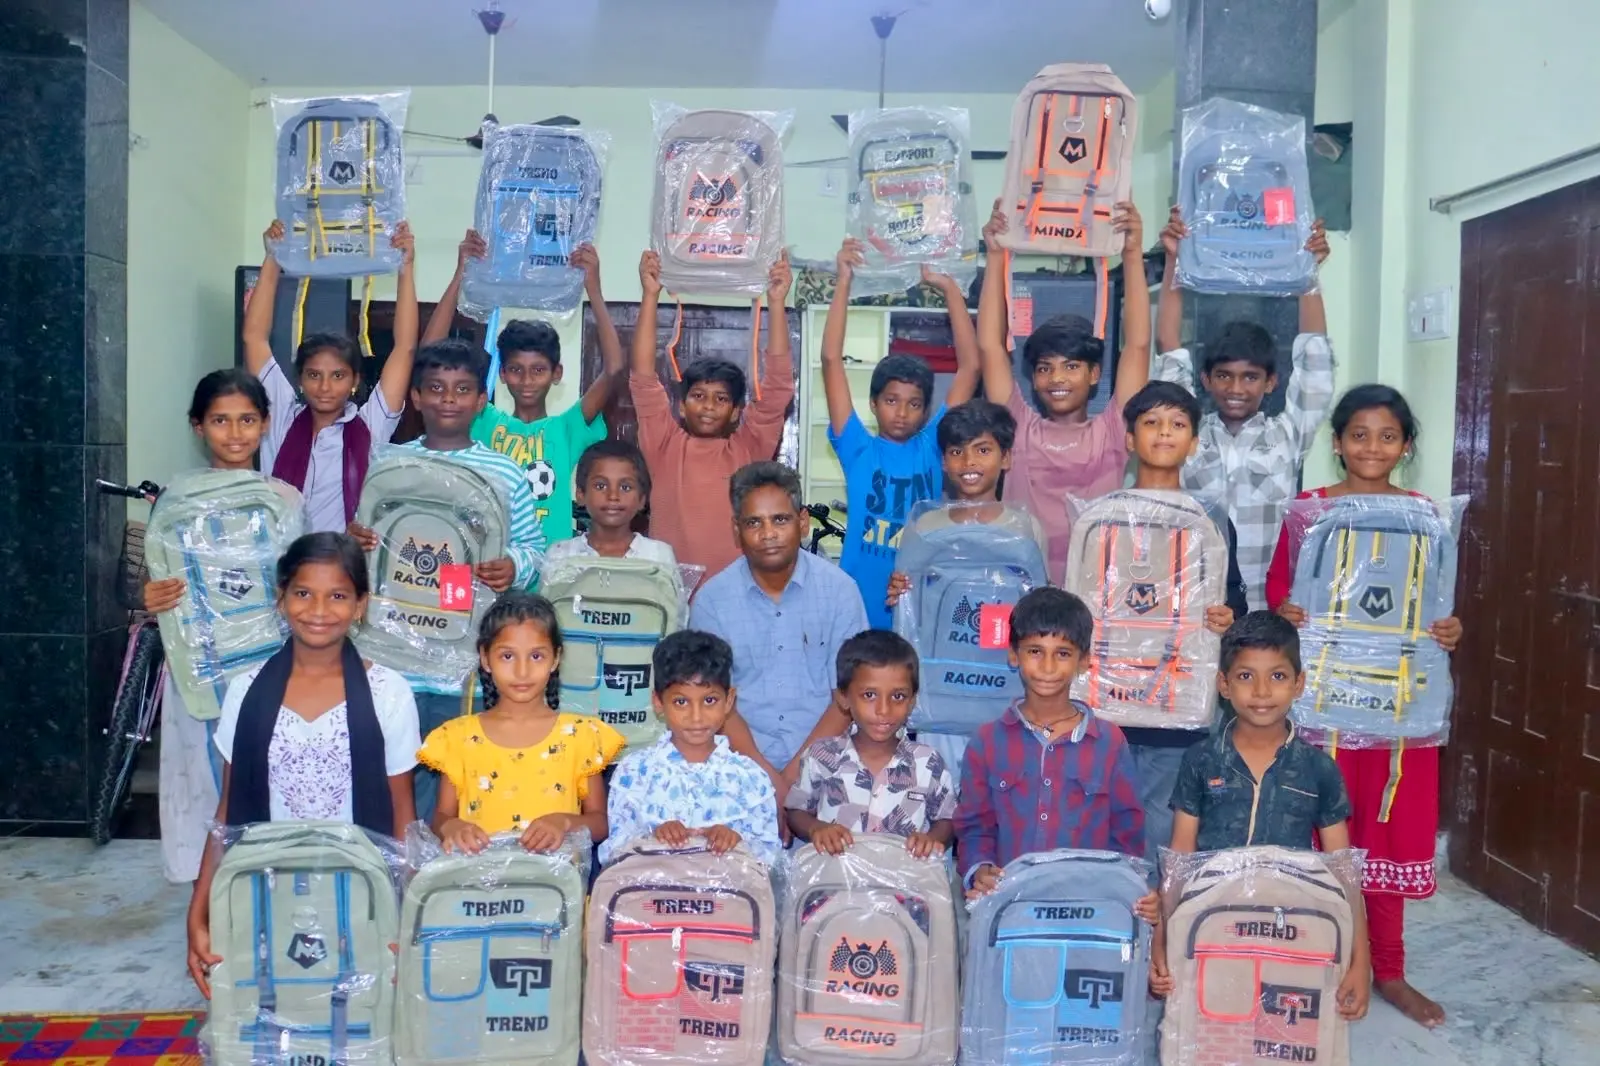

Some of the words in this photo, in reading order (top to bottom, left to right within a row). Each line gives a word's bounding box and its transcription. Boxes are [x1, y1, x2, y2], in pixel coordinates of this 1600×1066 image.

[1220, 249, 1275, 260] RACING
[393, 570, 440, 589] RACIN
[387, 609, 449, 629] RACING
[581, 609, 632, 626] TREND
[948, 630, 981, 646] RAC
[943, 671, 1006, 688] RACING
[598, 711, 647, 724] TREND
[462, 899, 525, 917] TREND
[652, 899, 714, 915] TREND
[1034, 906, 1096, 920] TREND
[1235, 922, 1298, 940] TREND
[826, 980, 900, 998] RACING
[486, 1015, 549, 1032] TREND
[680, 1018, 740, 1038] TREND
[824, 1026, 897, 1047] RACING
[1253, 1039, 1317, 1062] TREND
